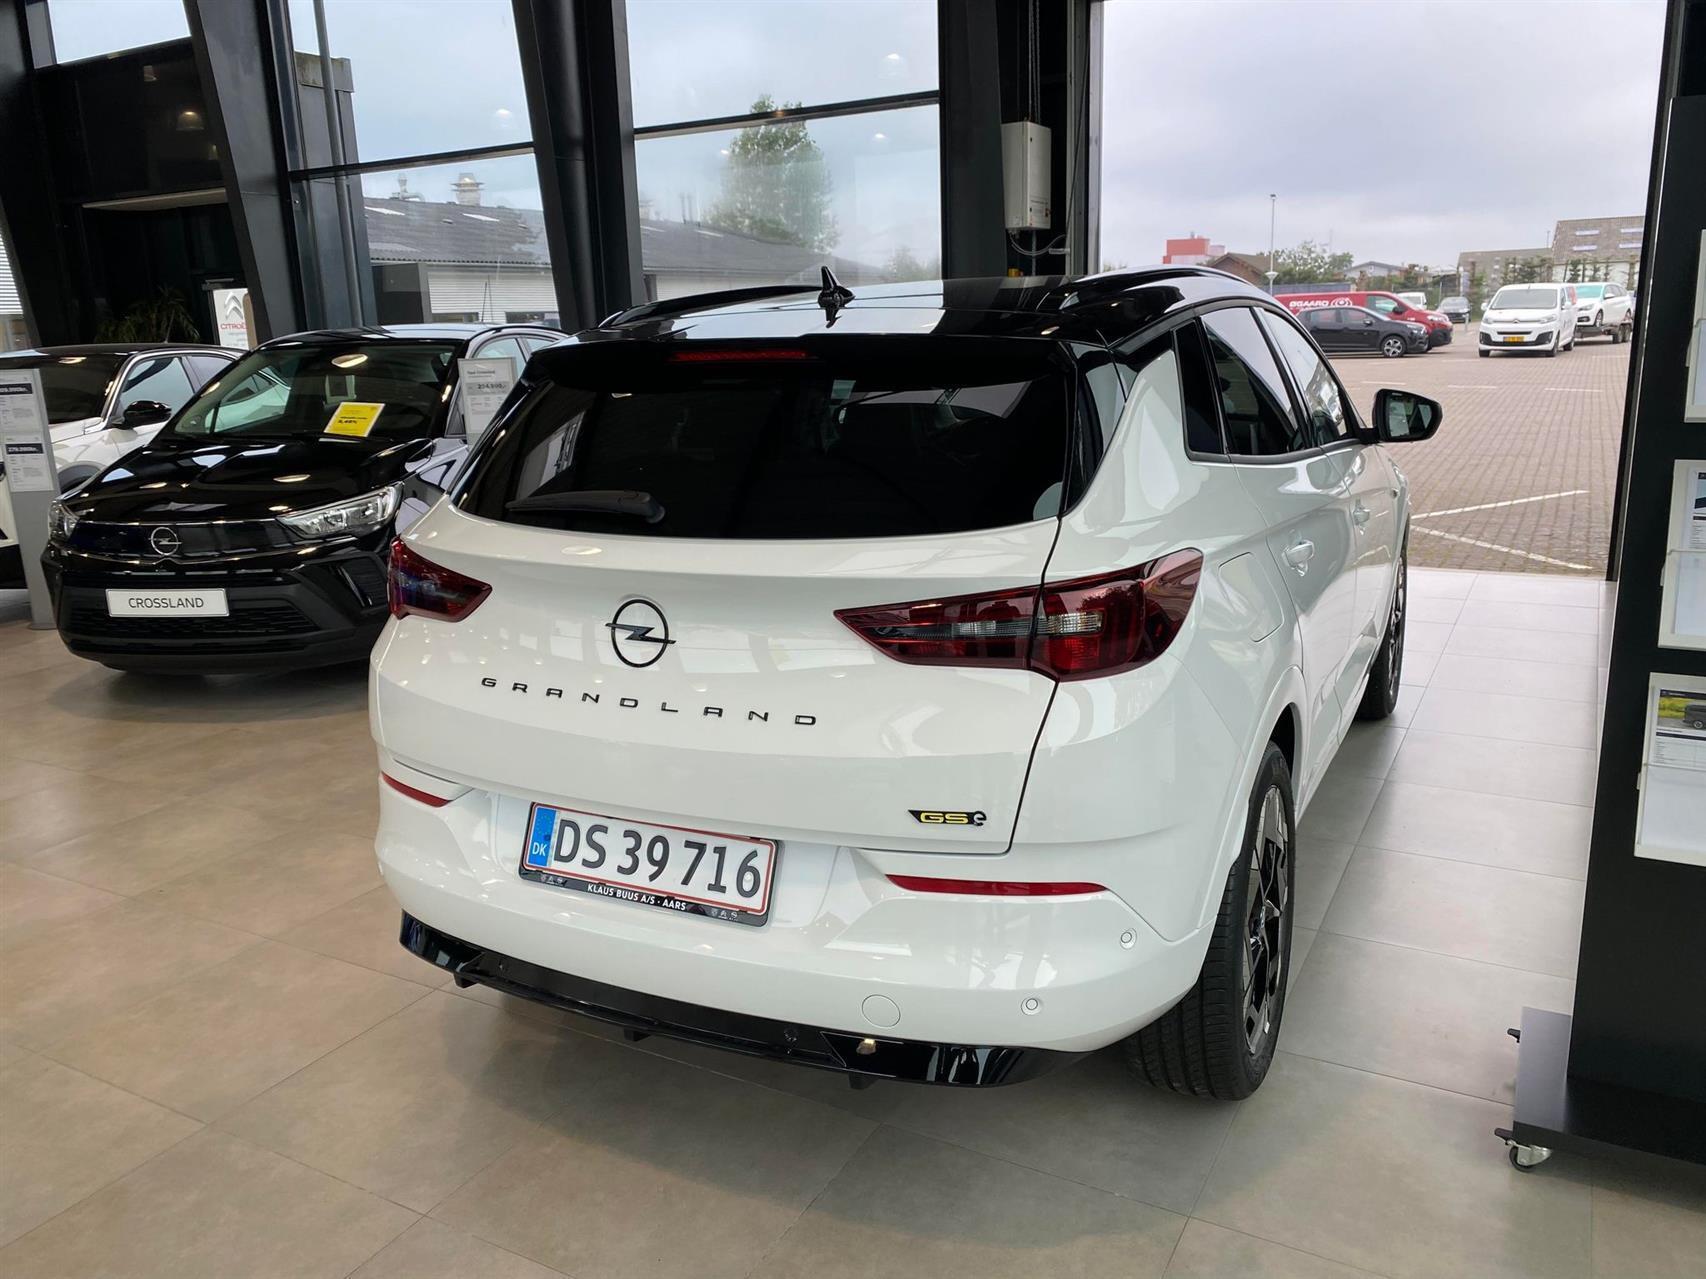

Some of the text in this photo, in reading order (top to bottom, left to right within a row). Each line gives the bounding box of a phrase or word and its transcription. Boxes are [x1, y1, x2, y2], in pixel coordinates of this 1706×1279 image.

[128, 597, 204, 609] CROSSLAND
[481, 677, 816, 726] GRANDLAND
[531, 842, 547, 857] DK
[553, 819, 761, 898] DS 39 716
[587, 883, 614, 896] KLAUS
[616, 889, 639, 902] BUUS
[640, 894, 655, 905] A/S
[662, 899, 687, 911] AARS
